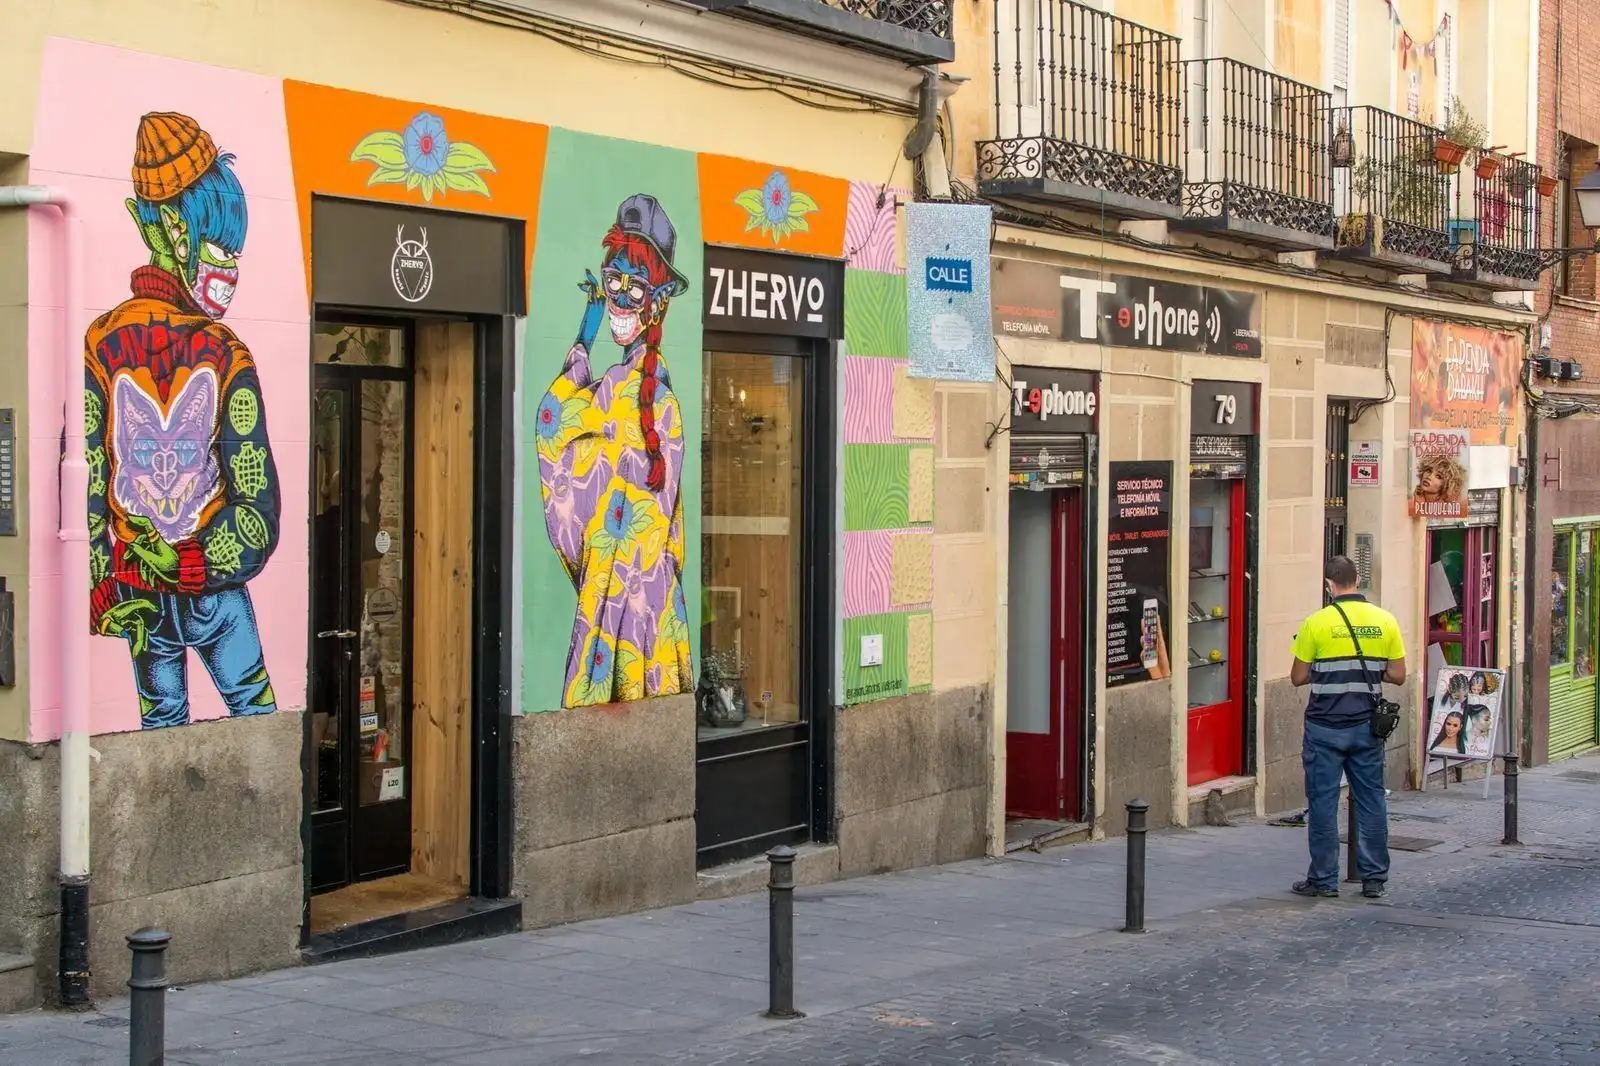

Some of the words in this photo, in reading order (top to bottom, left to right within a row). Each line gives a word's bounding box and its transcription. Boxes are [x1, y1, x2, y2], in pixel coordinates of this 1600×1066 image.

[929, 266, 968, 284] CALLE
[709, 267, 825, 322] ZHERVO
[1215, 394, 1237, 424] 79
[1117, 480, 1140, 491] SERVICIO
[1142, 477, 1163, 489] TÉCNICO
[1117, 491, 1144, 504] TELEFONÍA
[1145, 490, 1160, 503] MÓVIL
[1120, 508, 1125, 518] E
[1125, 504, 1158, 517] INFORMÁTICA
[1415, 501, 1461, 517] PELUQUERÍA
[362, 718, 376, 727] VISA
